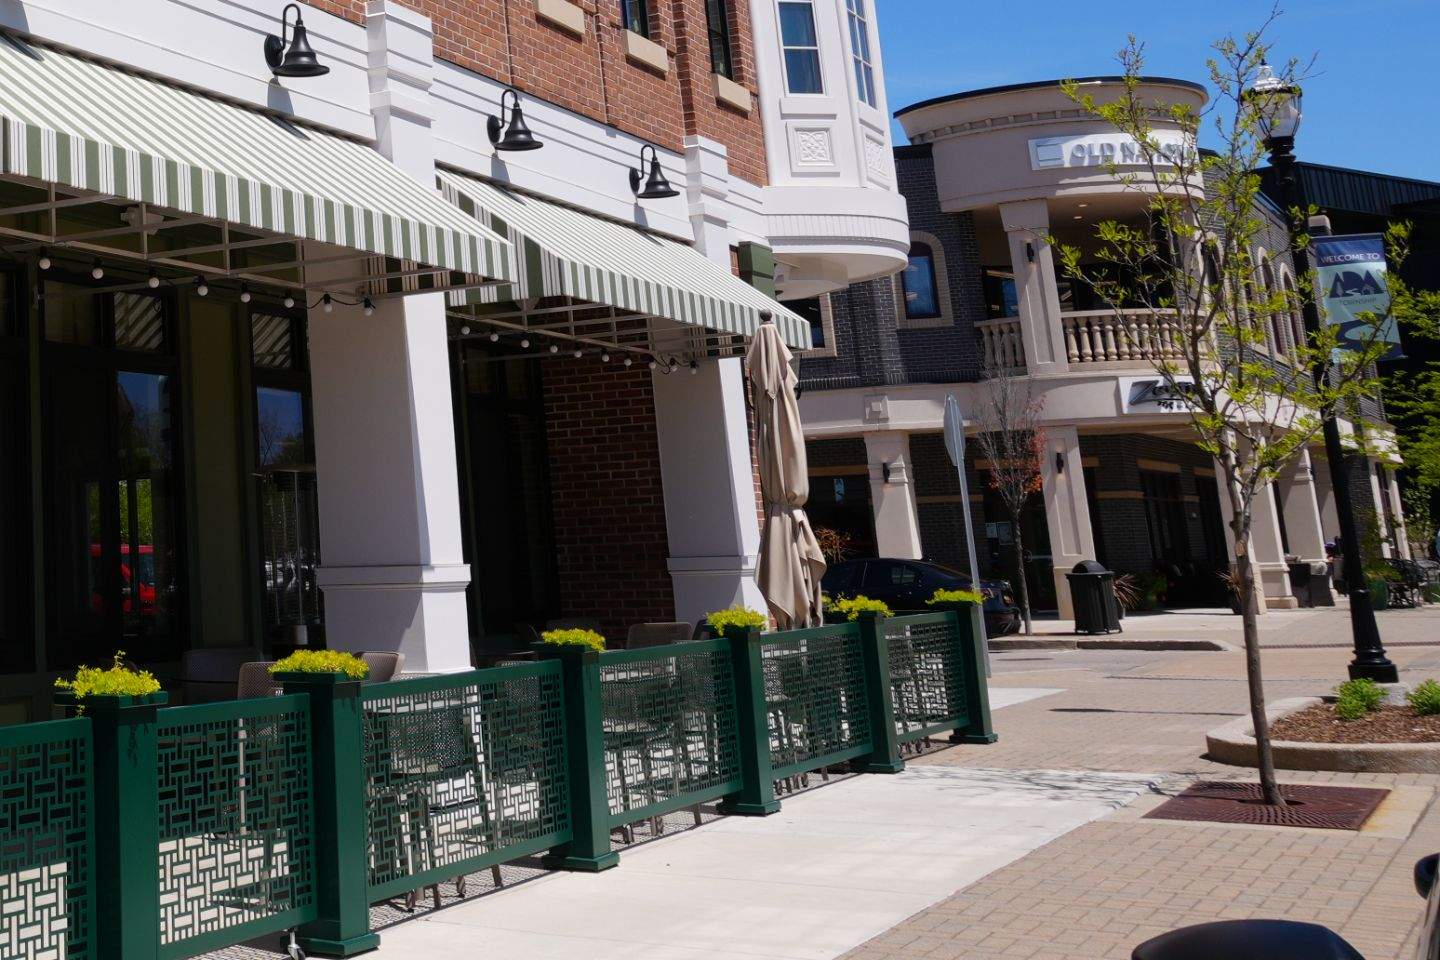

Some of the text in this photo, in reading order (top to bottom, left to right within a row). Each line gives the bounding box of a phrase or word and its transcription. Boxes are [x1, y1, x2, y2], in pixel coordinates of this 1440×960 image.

[1072, 143, 1115, 158] OLD
[1321, 252, 1380, 263] WELCOME TO
[1329, 269, 1383, 298] ADA
